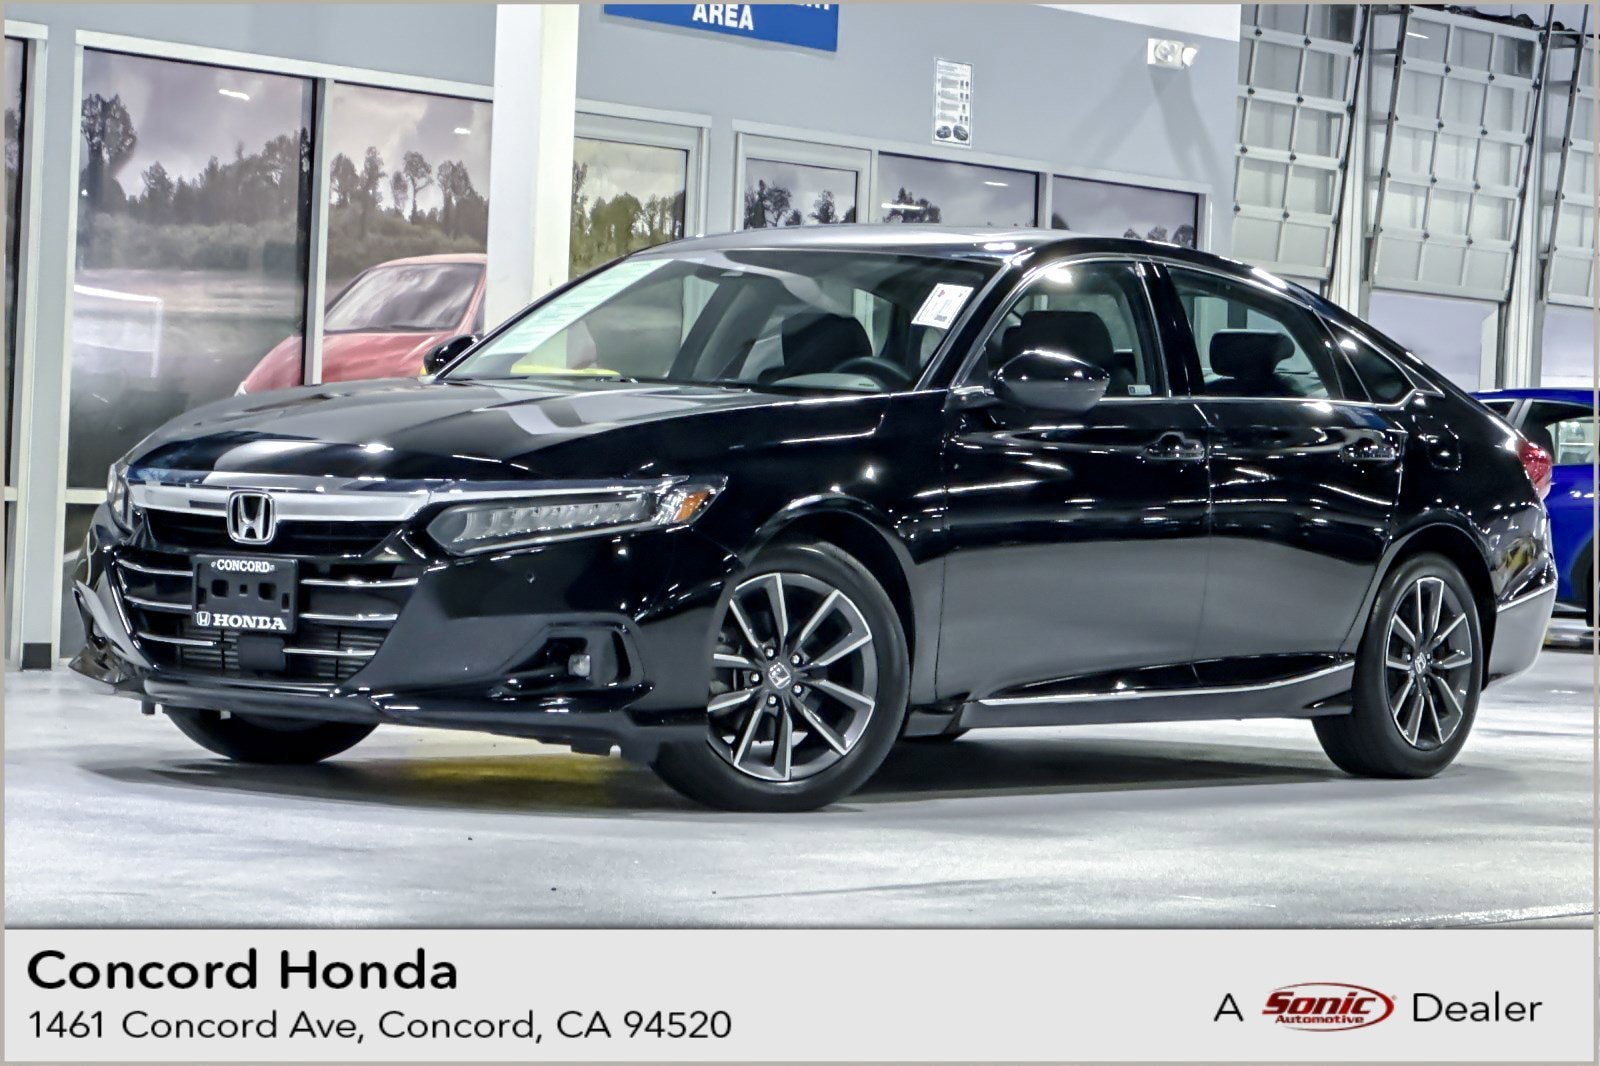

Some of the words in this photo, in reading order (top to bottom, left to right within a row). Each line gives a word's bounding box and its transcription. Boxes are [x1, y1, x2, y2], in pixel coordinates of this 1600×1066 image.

[692, 4, 754, 31] AREA
[216, 559, 271, 573] CONCORD
[213, 613, 287, 630] HONDA
